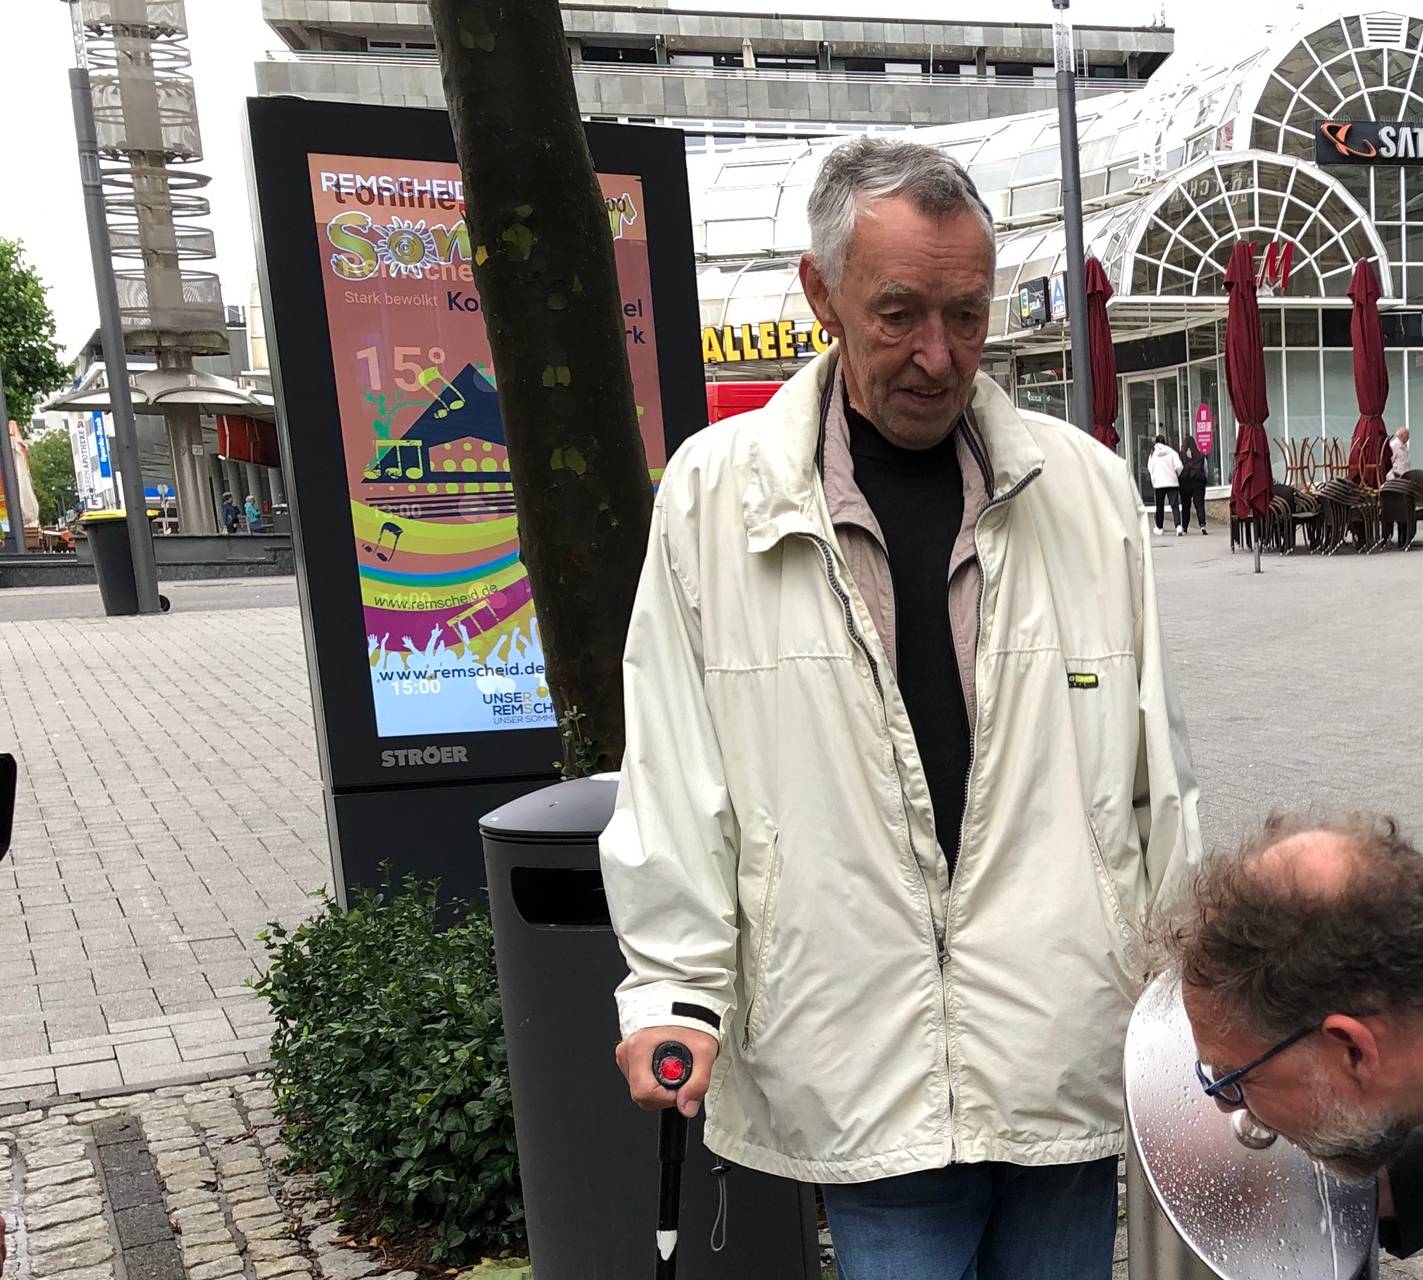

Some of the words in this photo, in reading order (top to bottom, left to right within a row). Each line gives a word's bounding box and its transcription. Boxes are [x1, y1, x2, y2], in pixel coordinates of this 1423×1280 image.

[344, 290, 381, 305] Stark
[384, 292, 438, 307] bewölkt
[447, 291, 479, 312] Ko
[379, 662, 545, 681] www.remscheid.de
[391, 679, 441, 696] 15:00
[482, 691, 532, 704] UNSER
[381, 745, 469, 768] STRÖER
